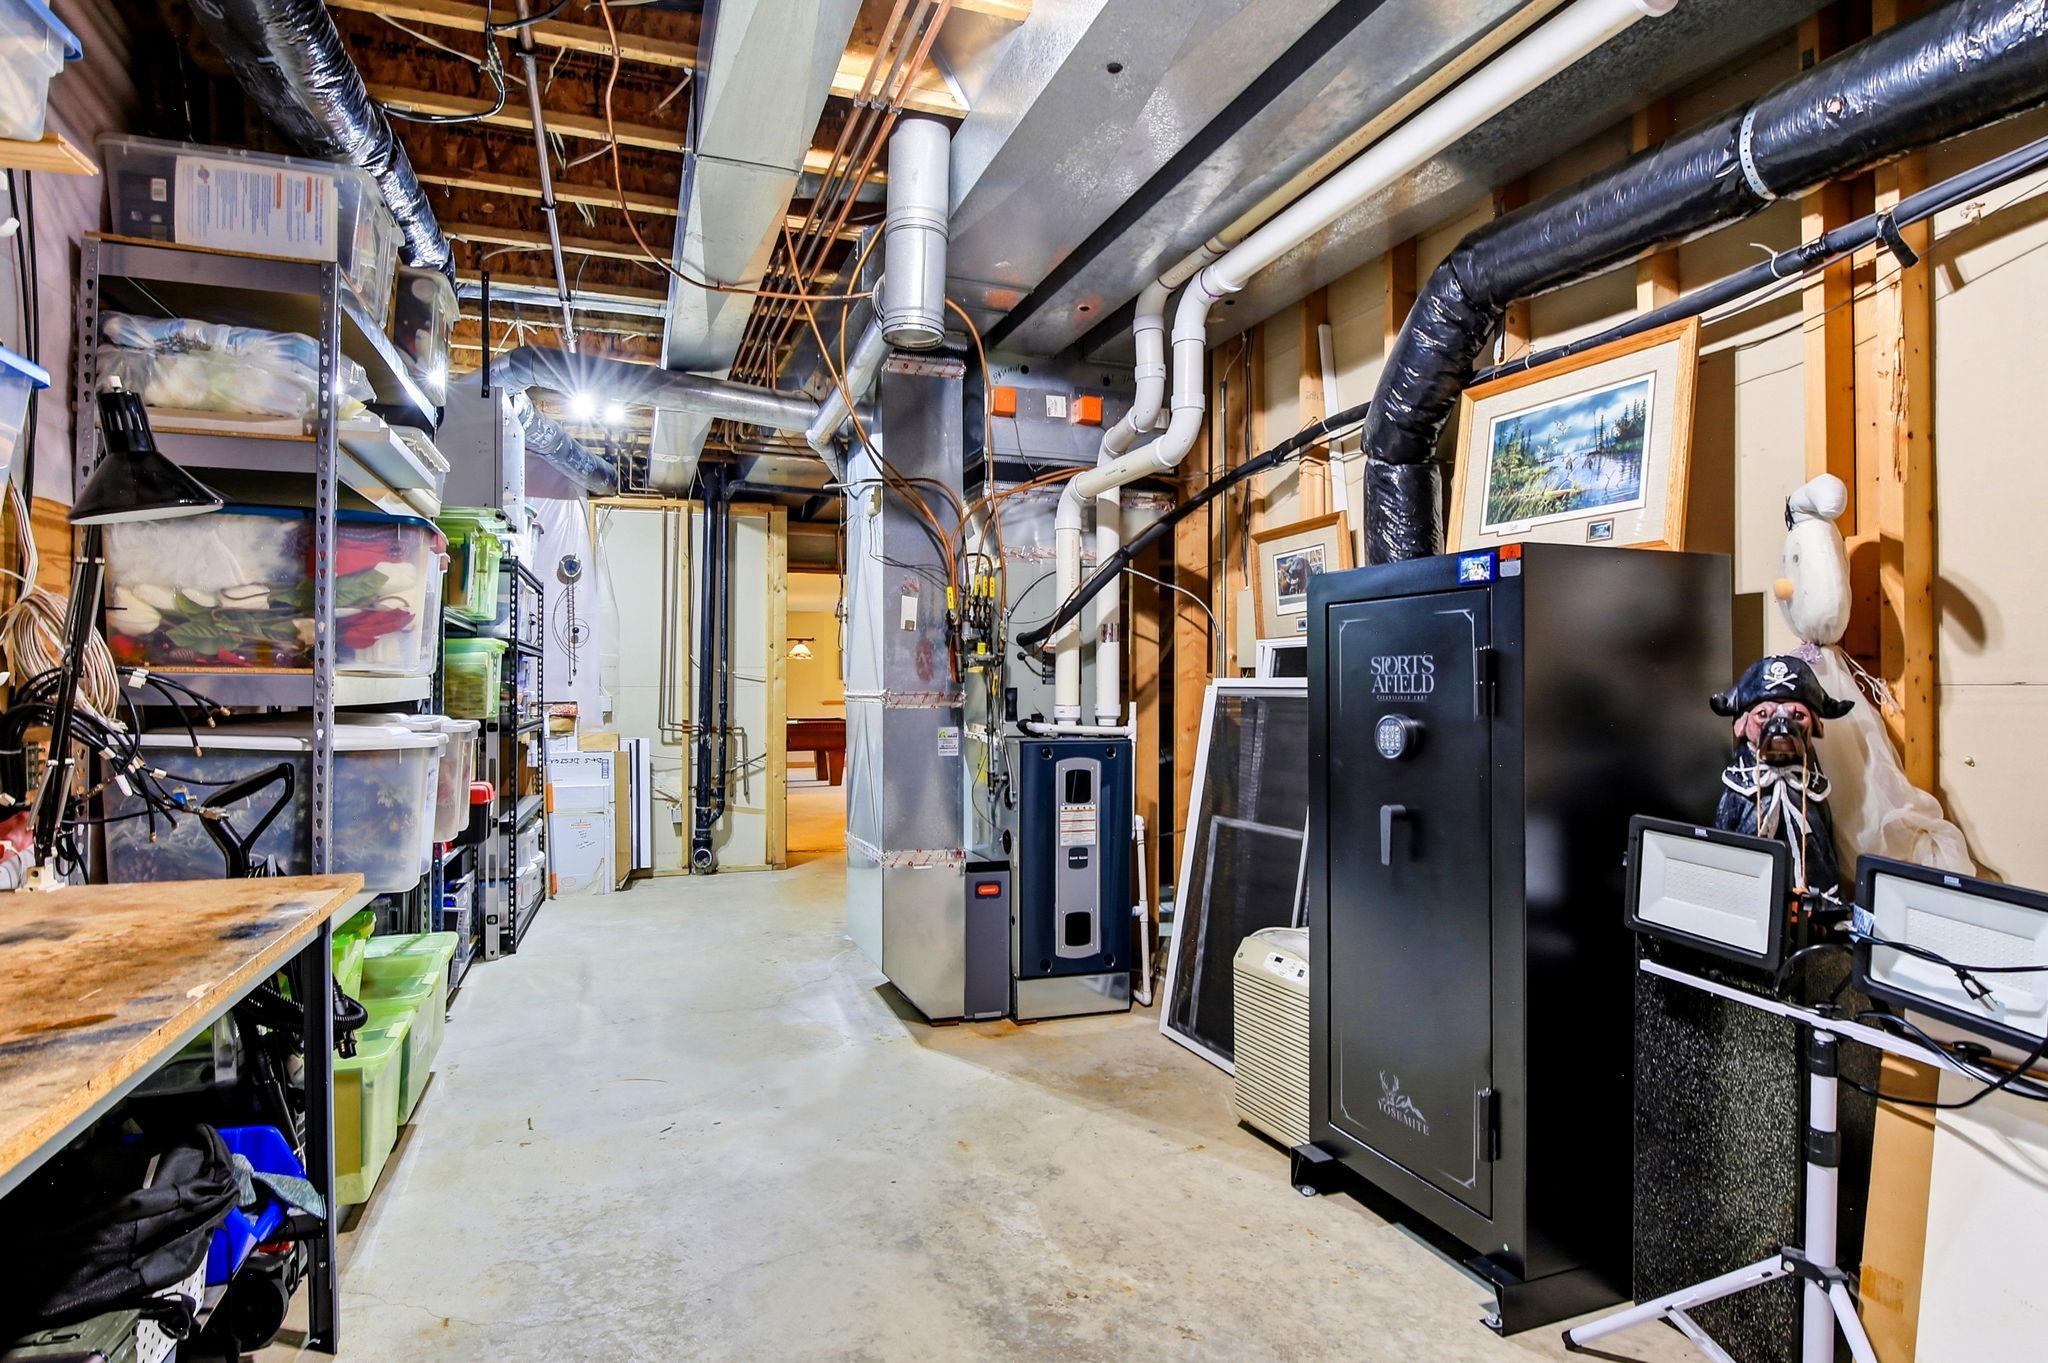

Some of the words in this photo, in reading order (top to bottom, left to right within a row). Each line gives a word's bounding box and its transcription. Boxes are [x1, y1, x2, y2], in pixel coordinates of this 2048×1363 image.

[1370, 655, 1435, 675] SPORTS
[1371, 674, 1435, 694] AFIELD
[1378, 1098, 1430, 1136] YOSEMITE
